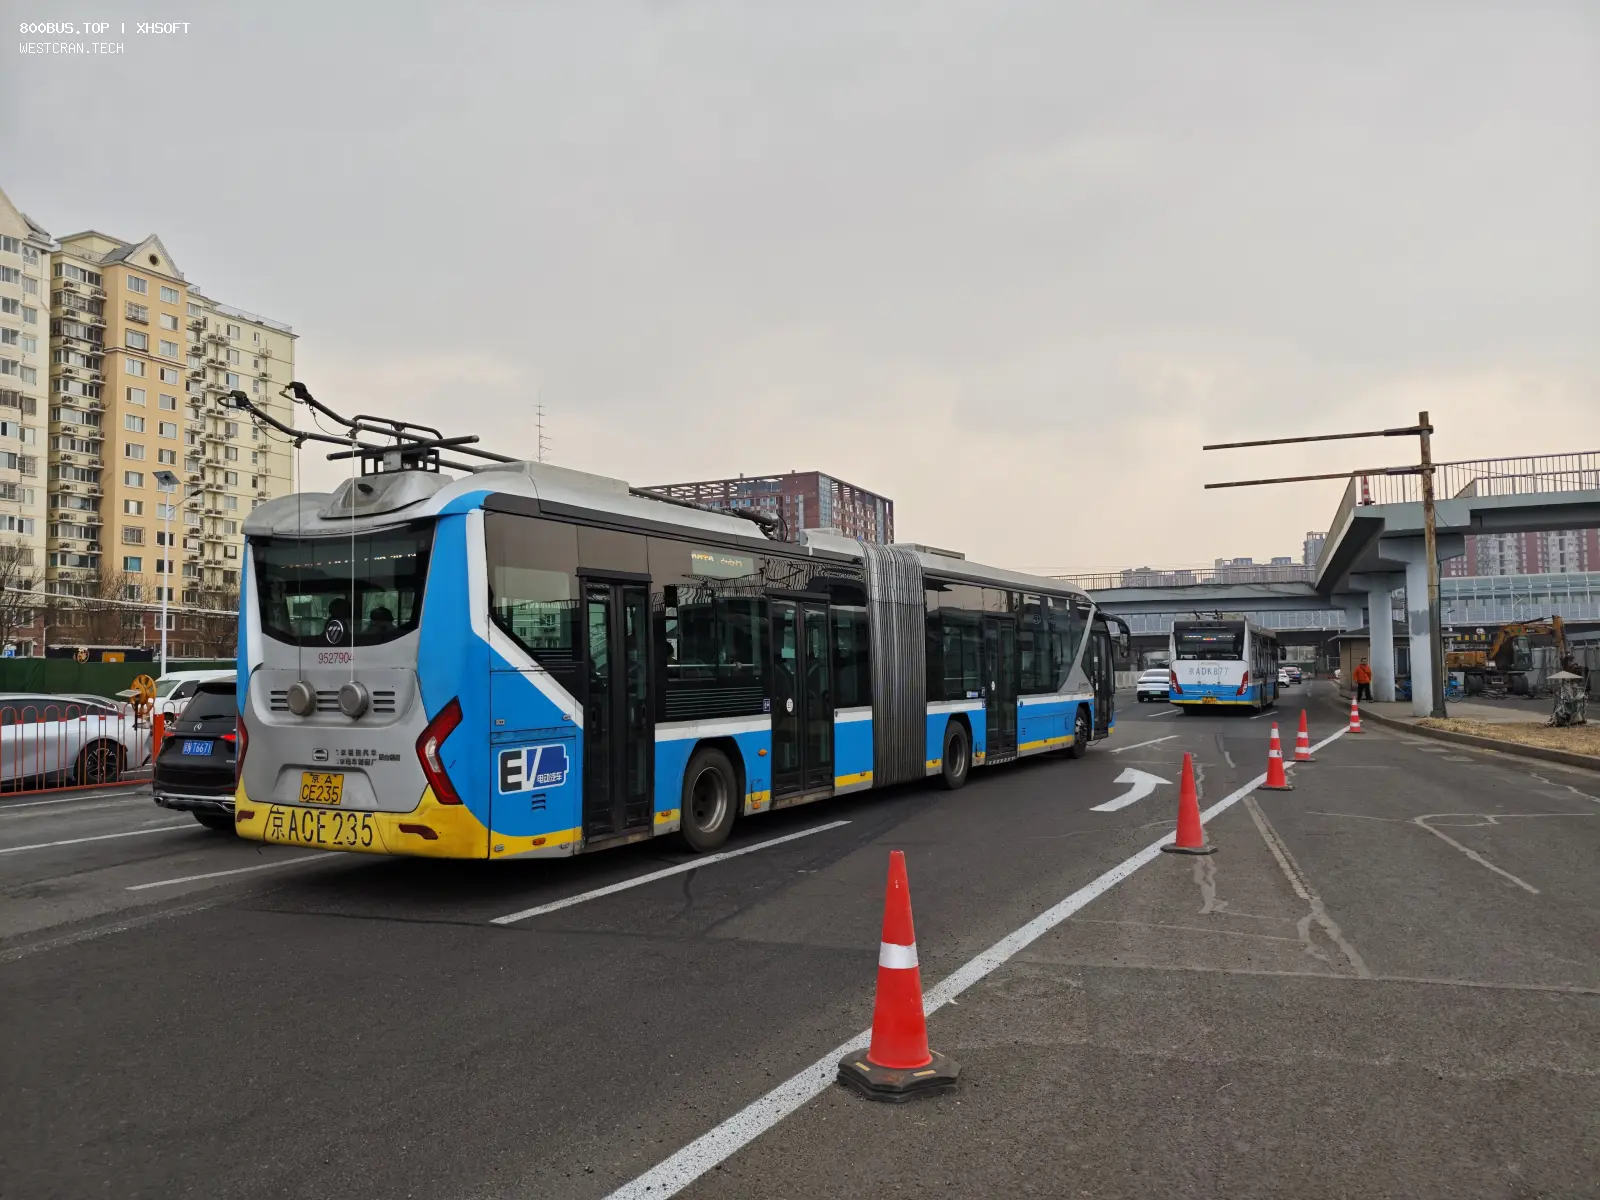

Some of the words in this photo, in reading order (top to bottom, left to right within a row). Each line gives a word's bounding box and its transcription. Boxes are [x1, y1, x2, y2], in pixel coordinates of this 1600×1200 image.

[500, 747, 542, 792] EV
[536, 771, 563, 783] 电动汽车
[301, 784, 340, 802] CE235
[270, 807, 373, 847] 京ACE235
